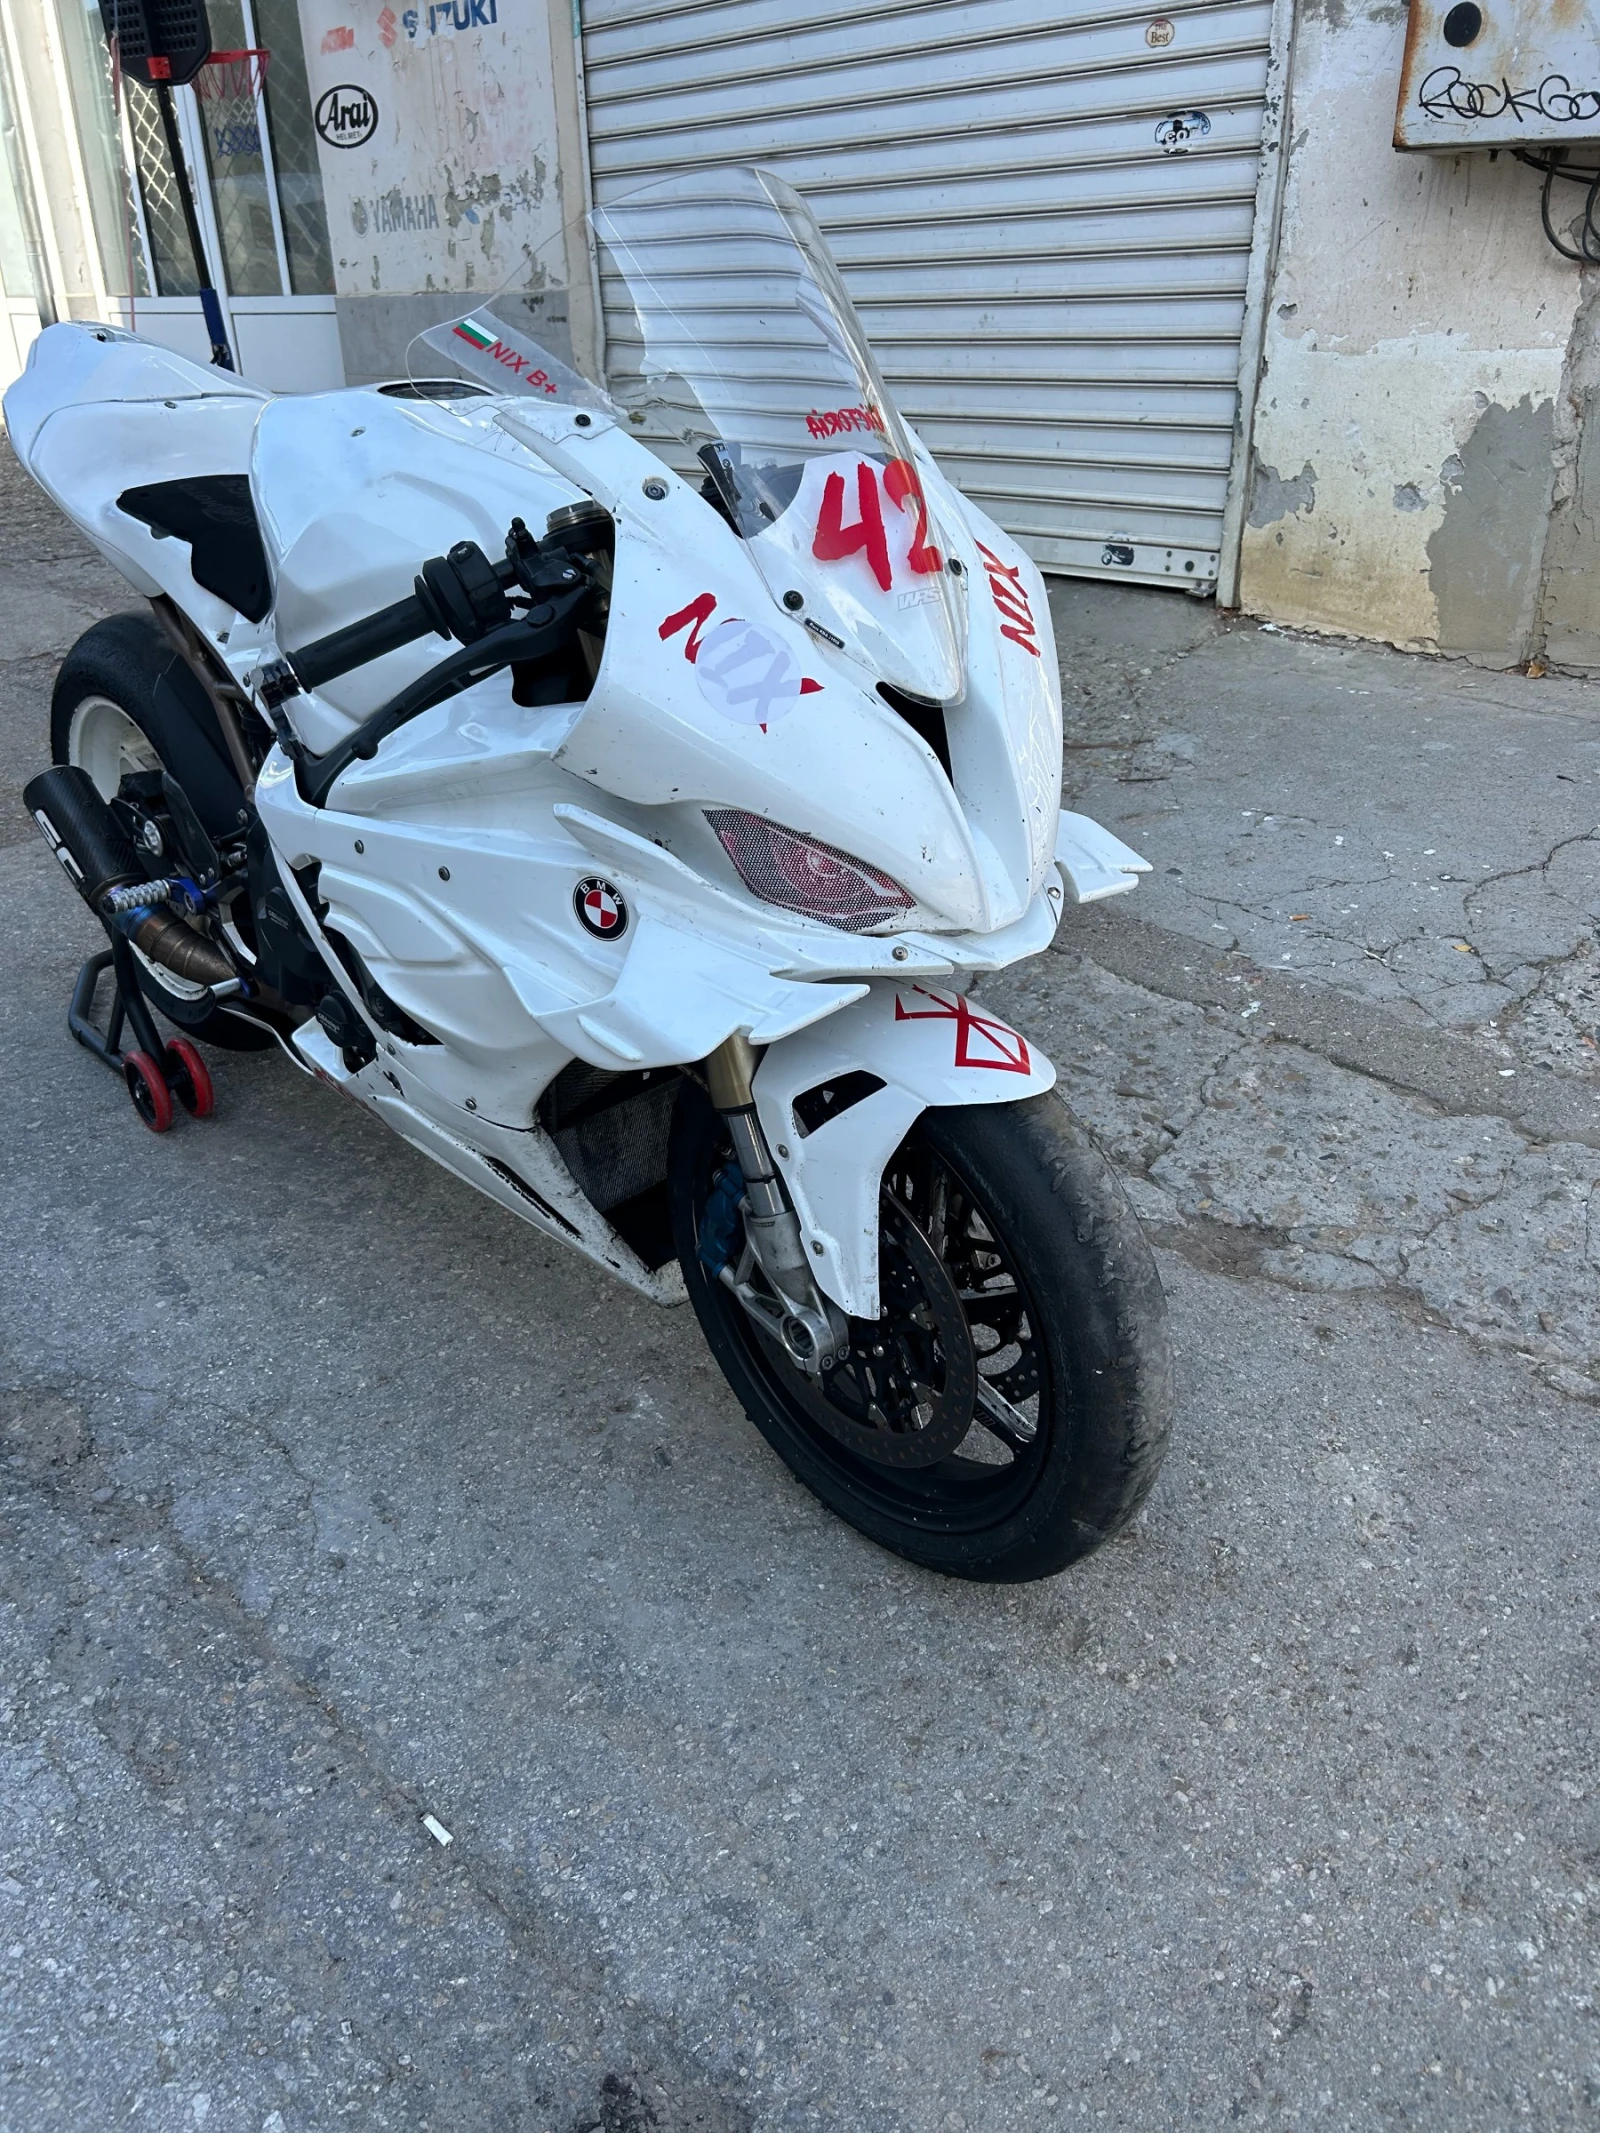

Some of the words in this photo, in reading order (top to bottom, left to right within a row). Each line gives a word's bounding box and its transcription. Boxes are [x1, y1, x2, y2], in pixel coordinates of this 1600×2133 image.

[1151, 31, 1170, 43] Best
[319, 92, 371, 131] Arai
[369, 194, 440, 234] YAMAHA
[486, 341, 530, 374] NIX
[812, 460, 944, 592] 42
[974, 538, 1041, 657] NIX
[658, 592, 826, 734] NIX
[580, 880, 623, 905] BMW
